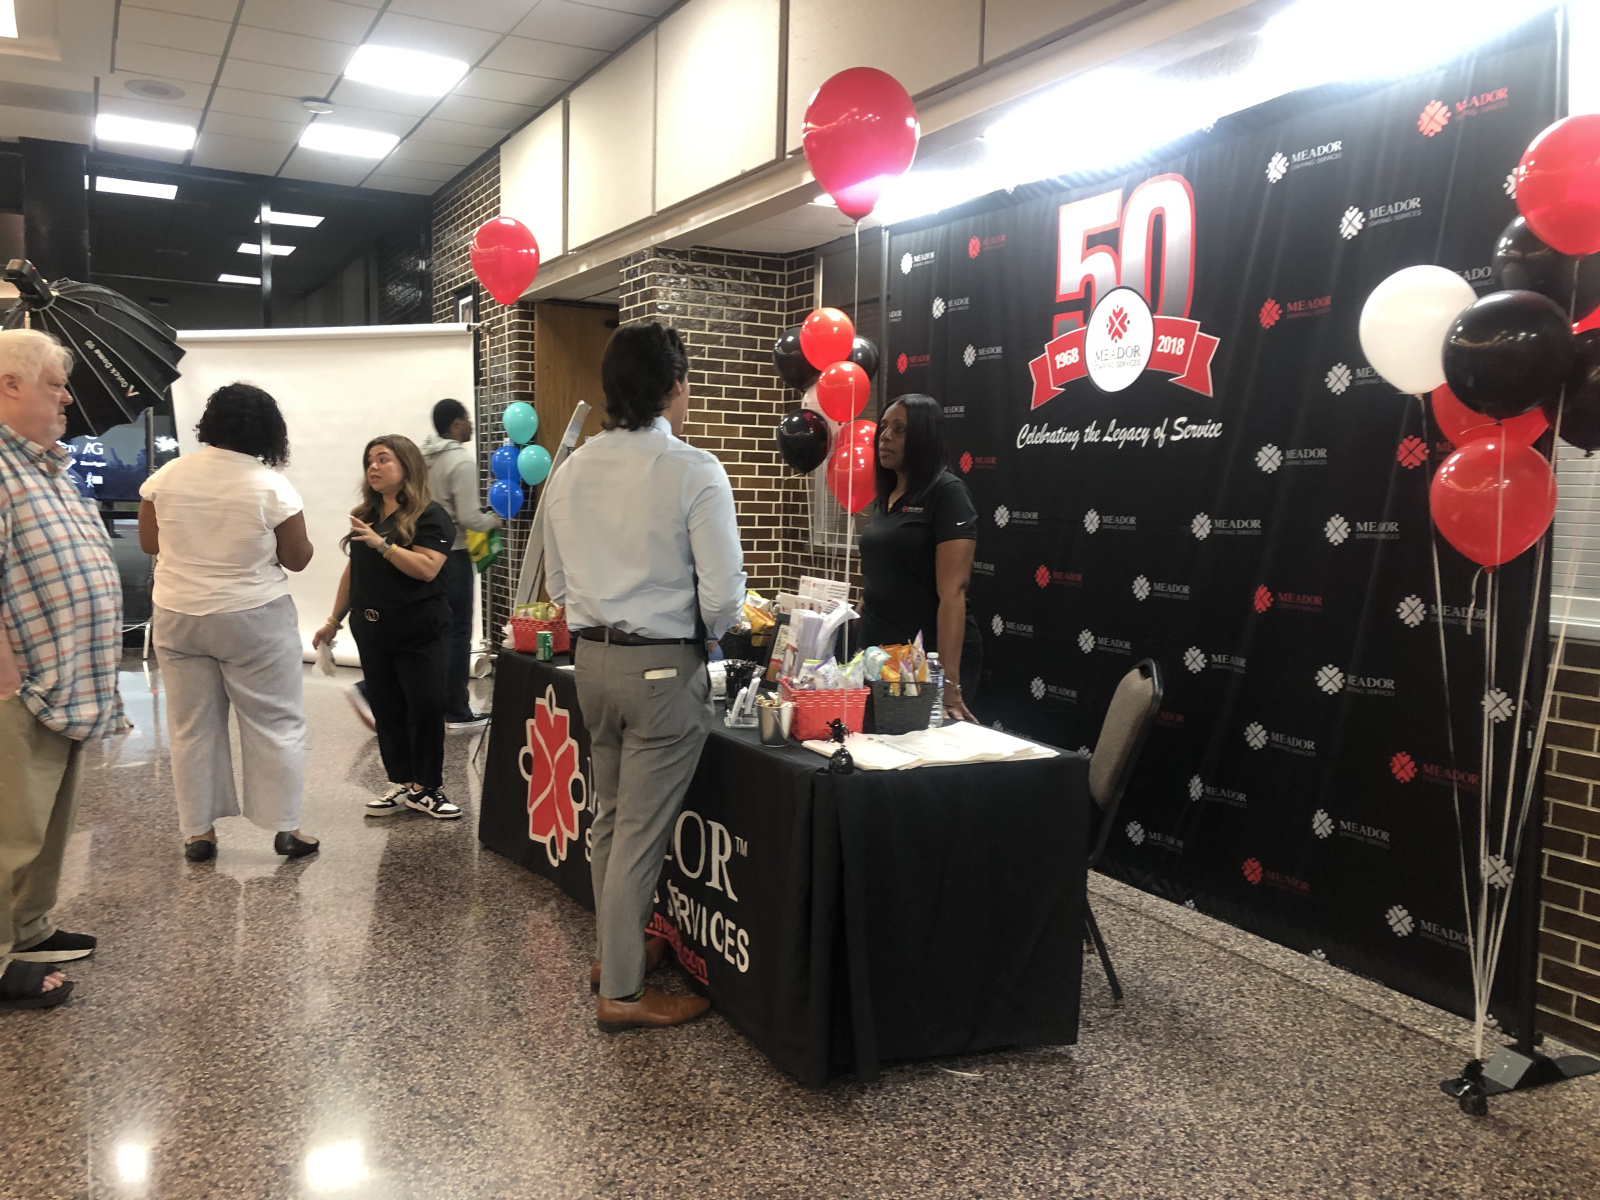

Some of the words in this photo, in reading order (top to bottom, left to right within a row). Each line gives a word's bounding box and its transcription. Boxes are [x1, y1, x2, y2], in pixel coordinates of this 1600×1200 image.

[1291, 140, 1343, 163] MEADOR
[1369, 197, 1421, 219] MEADOR
[1053, 173, 1196, 337] 50
[1453, 266, 1492, 282] ADO
[1286, 296, 1332, 312] MEADOR
[1095, 345, 1141, 362] MEADOR
[1156, 335, 1185, 355] 2018
[94, 348, 113, 369] Dome
[1054, 347, 1080, 369] 1968
[110, 367, 129, 388] Quick
[1016, 422, 1081, 451] Celebrating
[1083, 420, 1102, 443] the
[1102, 418, 1150, 449] Legacy
[1153, 417, 1169, 448] of
[1170, 416, 1223, 441] Service
[82, 442, 104, 455] AG
[1286, 448, 1327, 459] MEADOR
[1012, 511, 1039, 520] MEADOR
[1102, 515, 1136, 525] MEADOR
[1214, 519, 1261, 529] MEADOR
[1153, 582, 1190, 594] MEADOR
[1277, 592, 1322, 606] MEADOR
[1006, 621, 1034, 633] MEADOR
[1097, 637, 1132, 650] MEADOR
[1048, 684, 1078, 698] MEADOR
[1271, 731, 1316, 750] MEADOR
[1423, 763, 1480, 785] MEADOR
[1205, 785, 1247, 802] MEADOR
[1339, 820, 1391, 842] MEADOR
